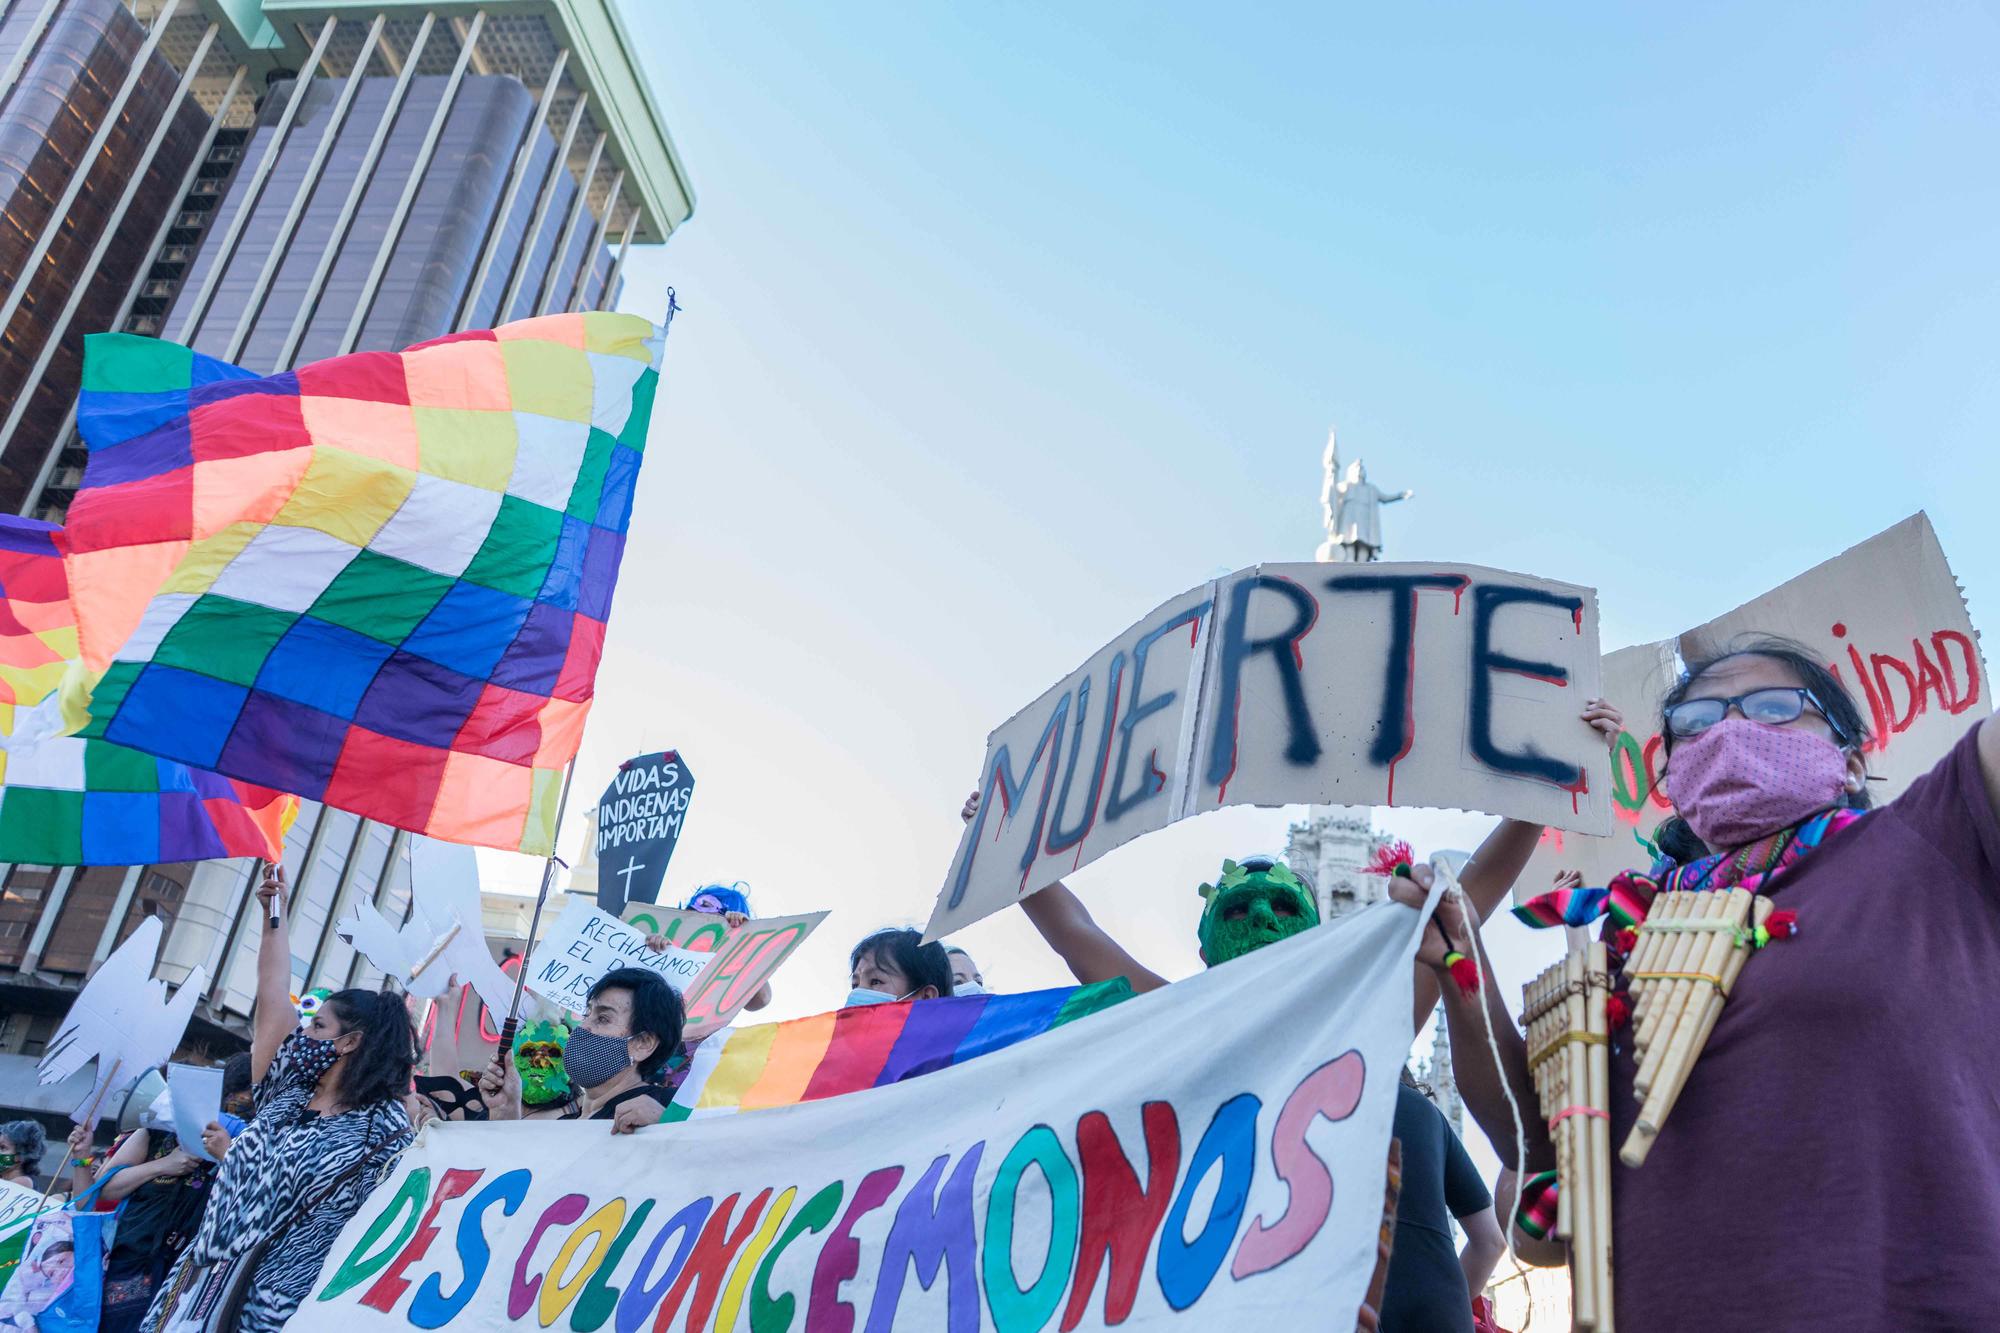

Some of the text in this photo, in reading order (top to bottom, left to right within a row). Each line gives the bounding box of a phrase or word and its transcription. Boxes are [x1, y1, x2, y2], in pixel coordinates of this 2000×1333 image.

[947, 574, 1587, 909] MUERTE
[614, 763, 679, 795] VIDAS
[600, 787, 691, 827] INDIGENAS
[599, 813, 682, 852] IMPORTAM
[567, 940, 592, 964] EL
[581, 916, 706, 977] RECHAZAMOS
[537, 959, 569, 983] NO
